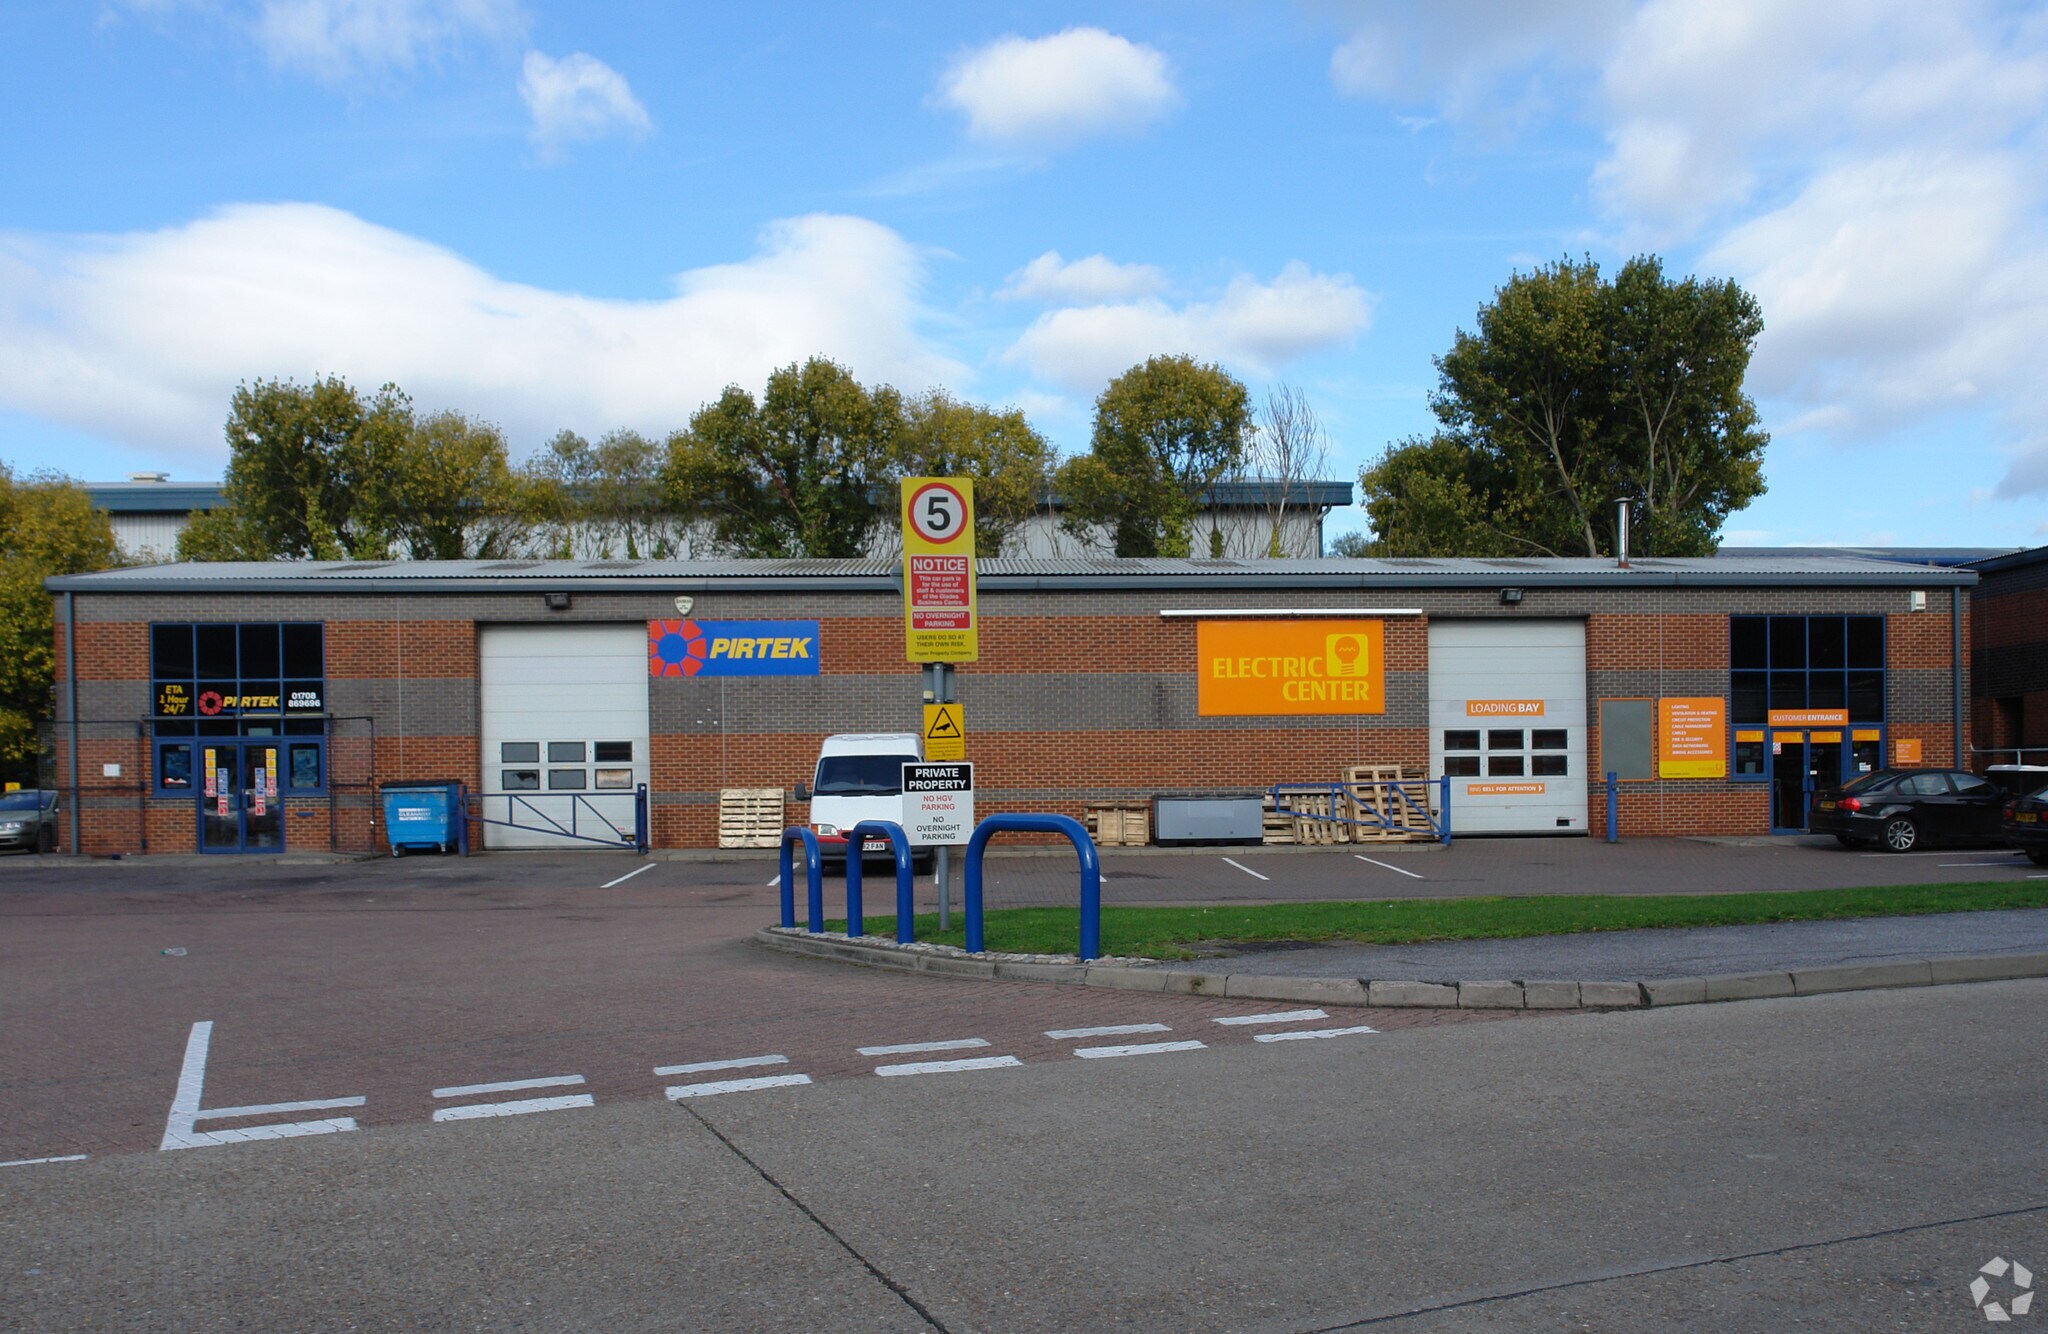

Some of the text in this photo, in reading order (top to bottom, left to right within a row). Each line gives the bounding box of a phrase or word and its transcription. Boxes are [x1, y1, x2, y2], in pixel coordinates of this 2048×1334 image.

[926, 496, 951, 531] 5
[913, 559, 966, 571] NOTICE
[709, 637, 813, 659] PIRTEK
[1213, 657, 1323, 678] ELECTRIC
[165, 685, 183, 694] ETA
[1282, 680, 1369, 701] CENTER
[160, 695, 189, 704] 1 Hour
[222, 696, 280, 708] PIRTEK
[288, 699, 321, 707] 869696
[163, 704, 186, 715] 24/7
[1470, 703, 1540, 713] LOADING BAY
[1772, 714, 1807, 722] CUSTOMER
[915, 768, 959, 778] PRIVATE
[908, 780, 966, 790] PROPERTY
[916, 824, 961, 832] OVERNIGHT
